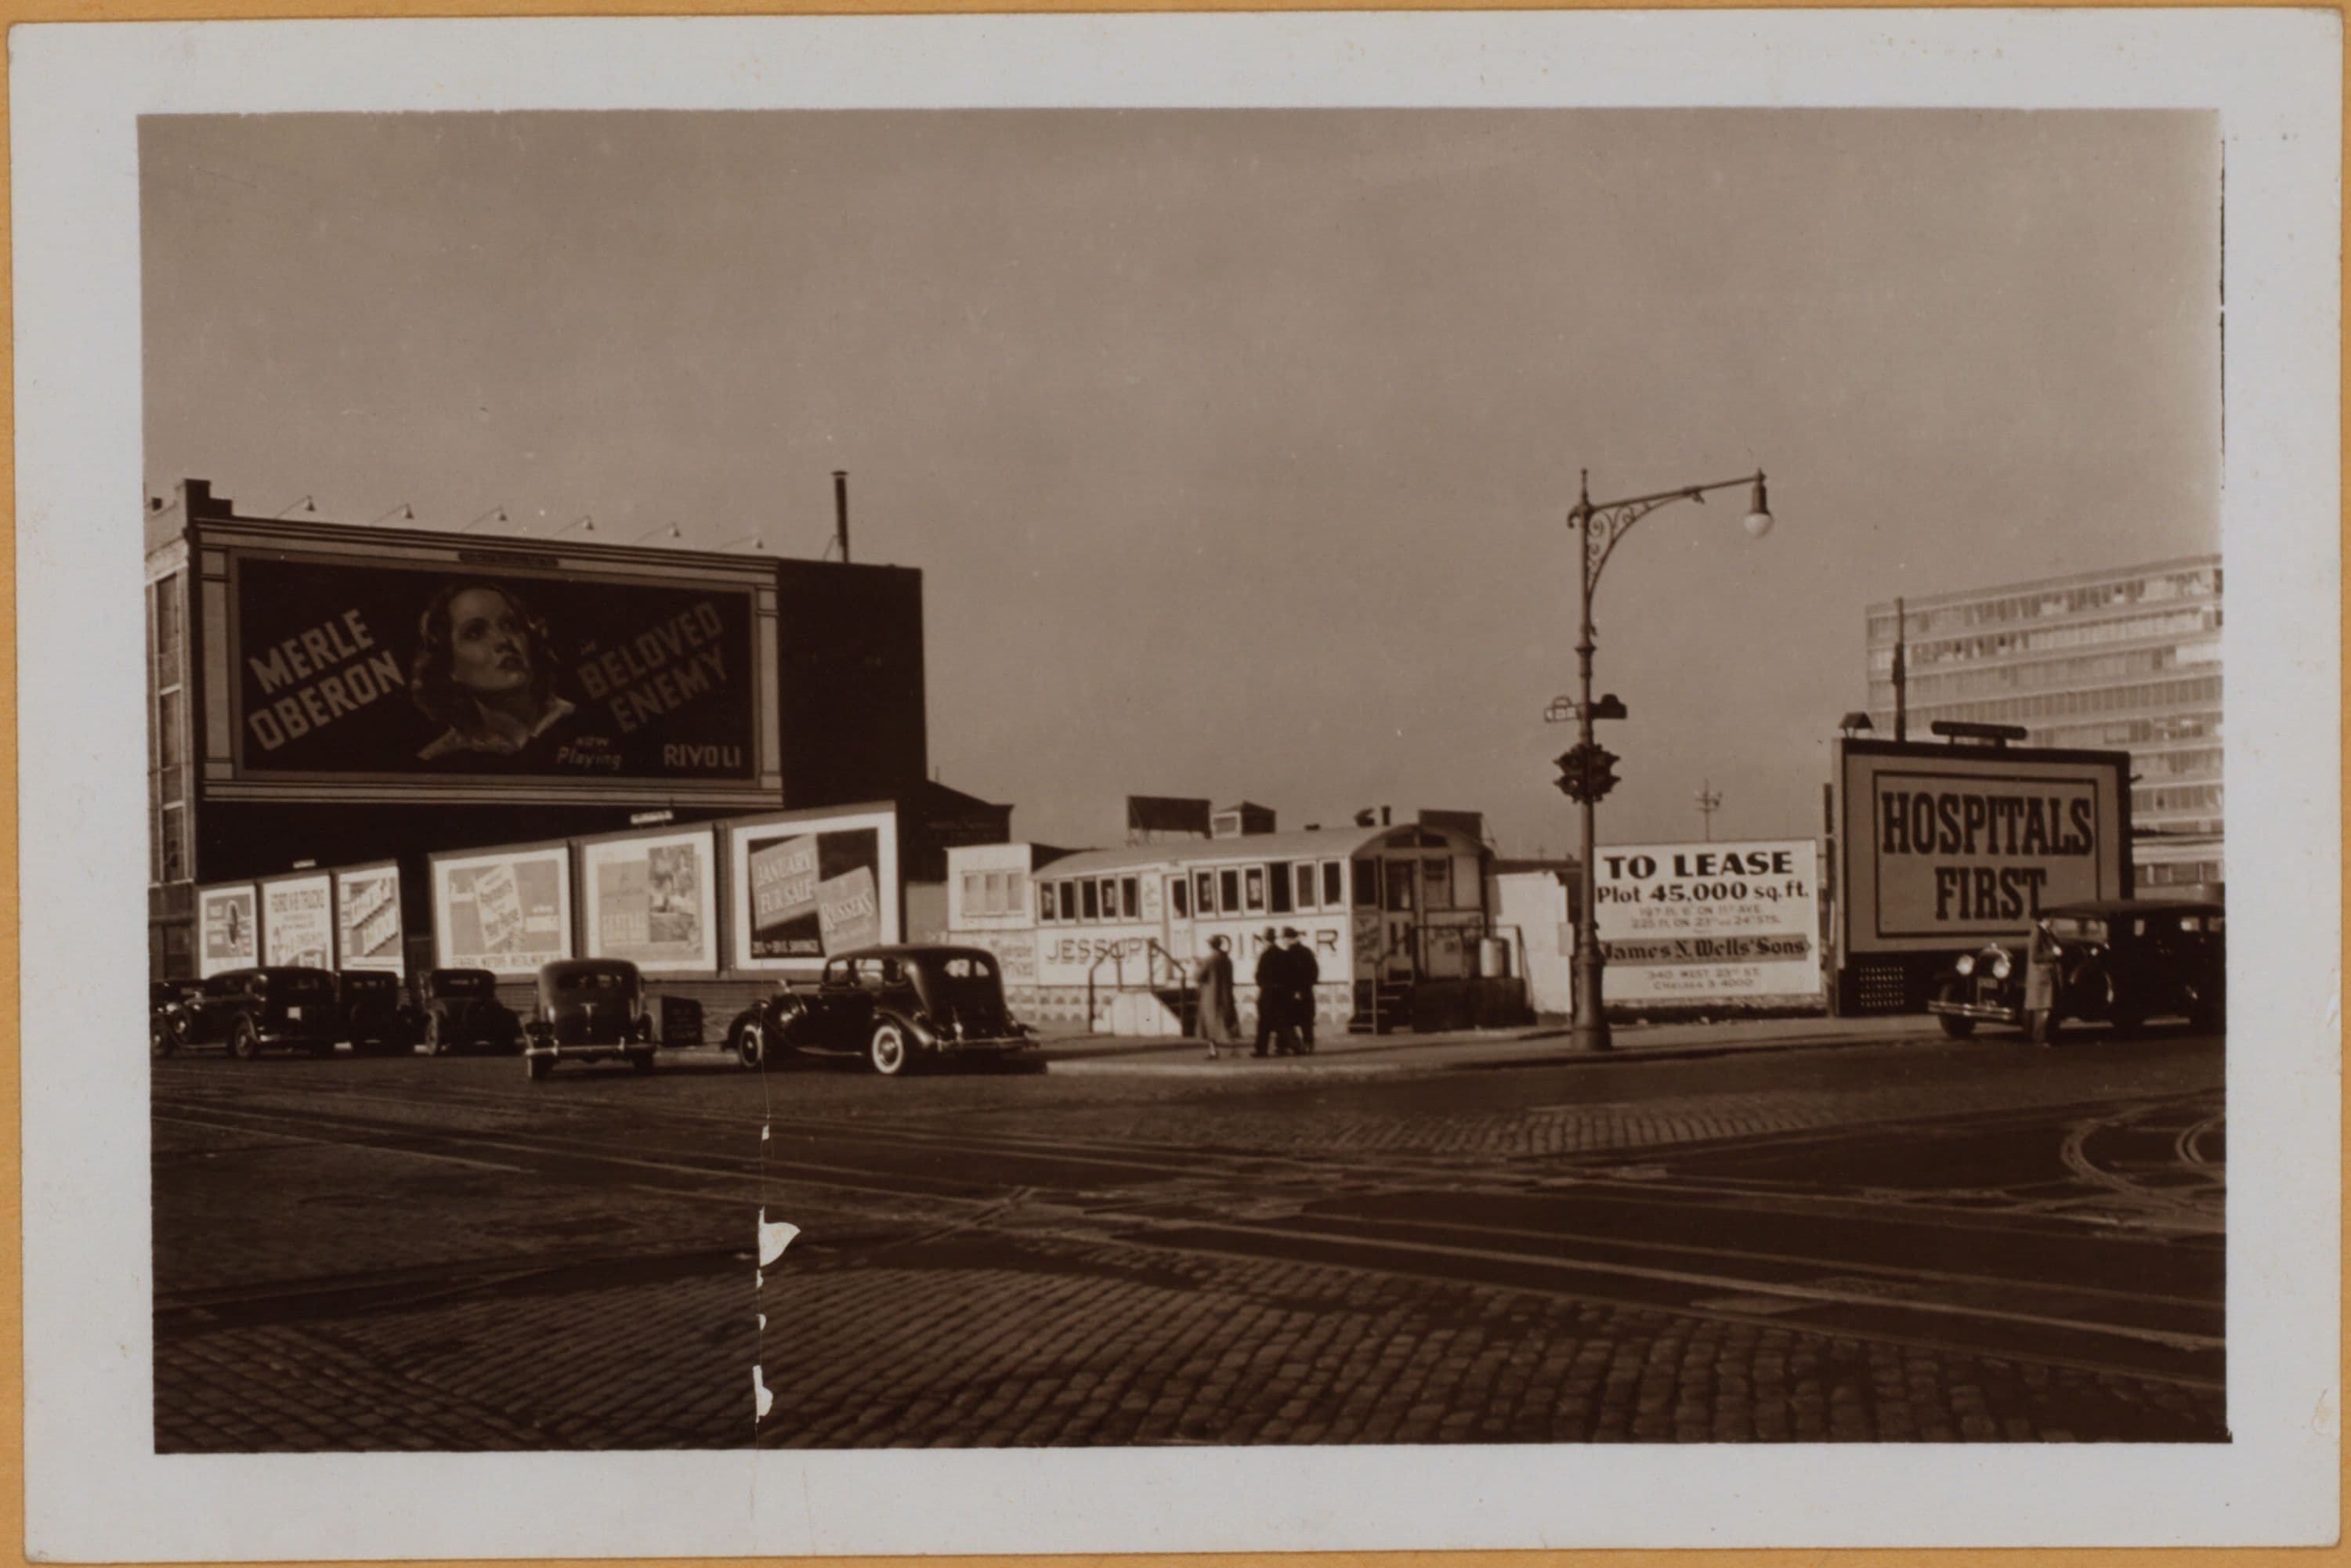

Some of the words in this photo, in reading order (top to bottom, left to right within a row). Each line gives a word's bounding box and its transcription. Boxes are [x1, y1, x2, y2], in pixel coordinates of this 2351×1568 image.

[248, 608, 374, 695] MERLE
[577, 601, 725, 700] BELOVED
[248, 649, 405, 751] OBERON
[609, 642, 728, 734] ENEMY
[557, 746, 623, 771] Playing
[664, 743, 742, 768] RIVOLI
[1881, 791, 2094, 856] HOSPITALS
[1603, 854, 1657, 880] TO
[1674, 851, 1793, 877] LEASE
[786, 877, 816, 906] SALE
[1597, 885, 1640, 903] Plot
[1934, 865, 2048, 922] FIRST
[1598, 941, 1671, 960] James
[1756, 936, 1806, 956] Sons
